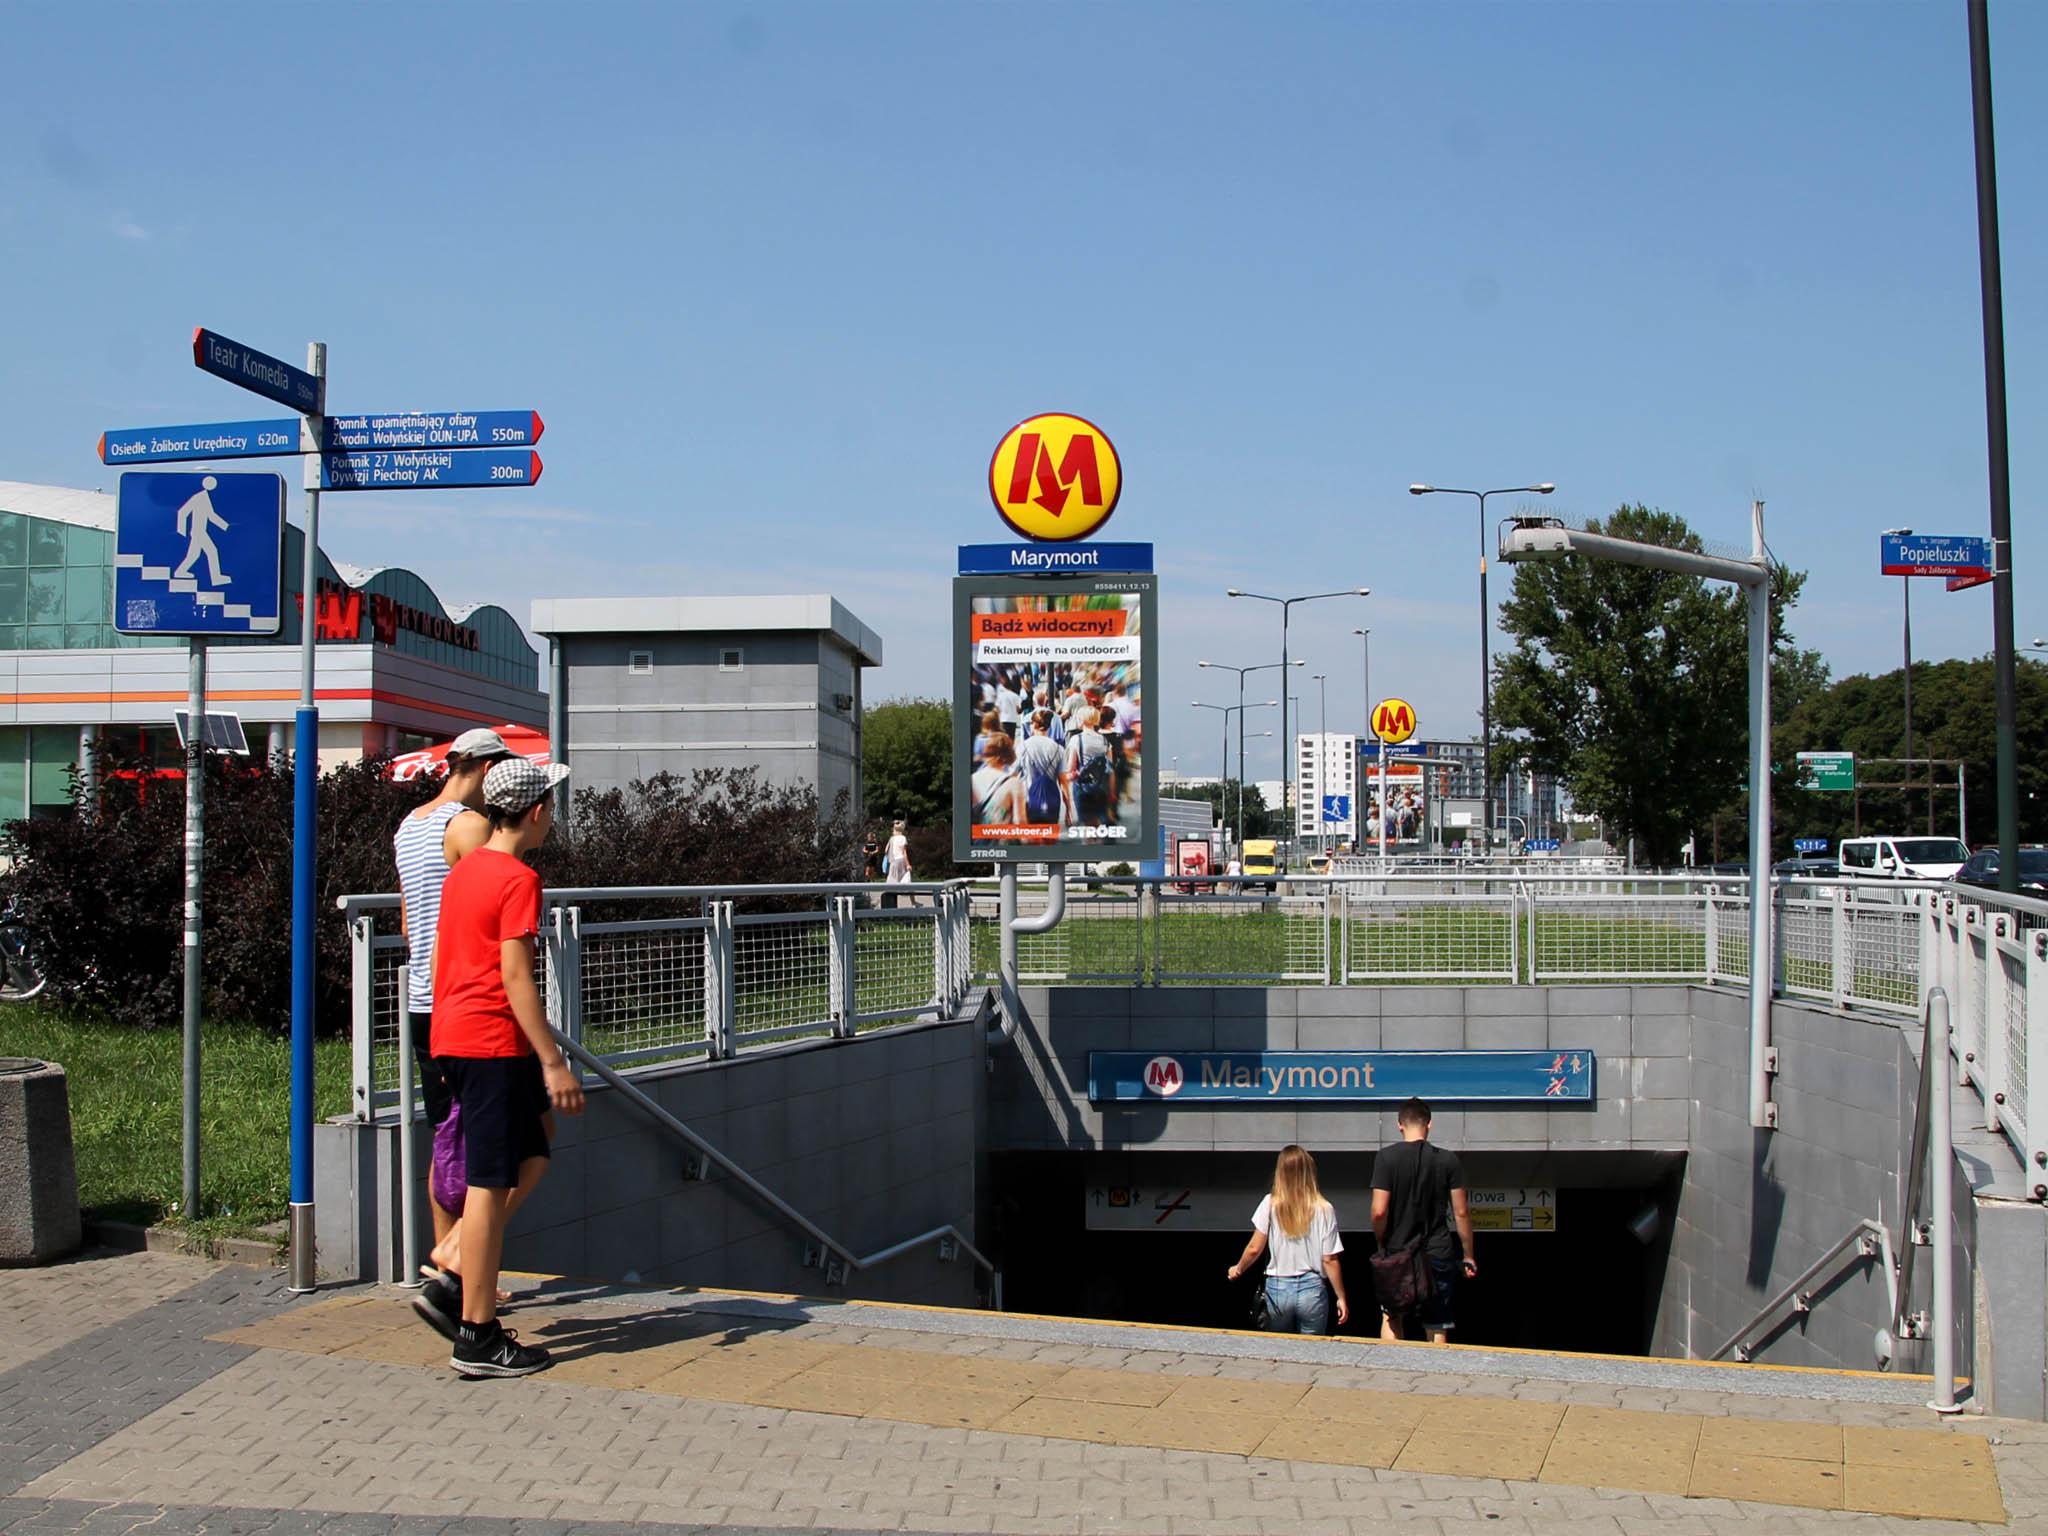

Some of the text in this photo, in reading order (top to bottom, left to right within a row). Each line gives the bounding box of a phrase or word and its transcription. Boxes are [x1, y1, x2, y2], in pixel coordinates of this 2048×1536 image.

[208, 337, 238, 369] Teatr
[243, 351, 288, 390] Komedia
[334, 415, 477, 431] Pomnik upamiętniający ofiary
[333, 430, 479, 446] Zbrodni Wołyńskiej OUN-UPA
[492, 429, 525, 441] 550m
[111, 433, 289, 456] Osiedle Żoliborz Urzędniczy 620m
[331, 454, 452, 470] Pomnik 27 Wołyńskiej
[331, 469, 439, 485] Dywizji Piechoty AK
[490, 466, 523, 479] 300m
[1011, 550, 1099, 568] Marymont
[1900, 546, 1969, 565] Popiełuszki
[982, 618, 1113, 636] Bądź widoczny!
[983, 645, 1033, 657] Reklamuj
[1034, 644, 1050, 657] się
[1070, 644, 1130, 656] outdoorze!
[982, 826, 1053, 838] www.stroer.pl
[1201, 1059, 1375, 1094] Marymont
